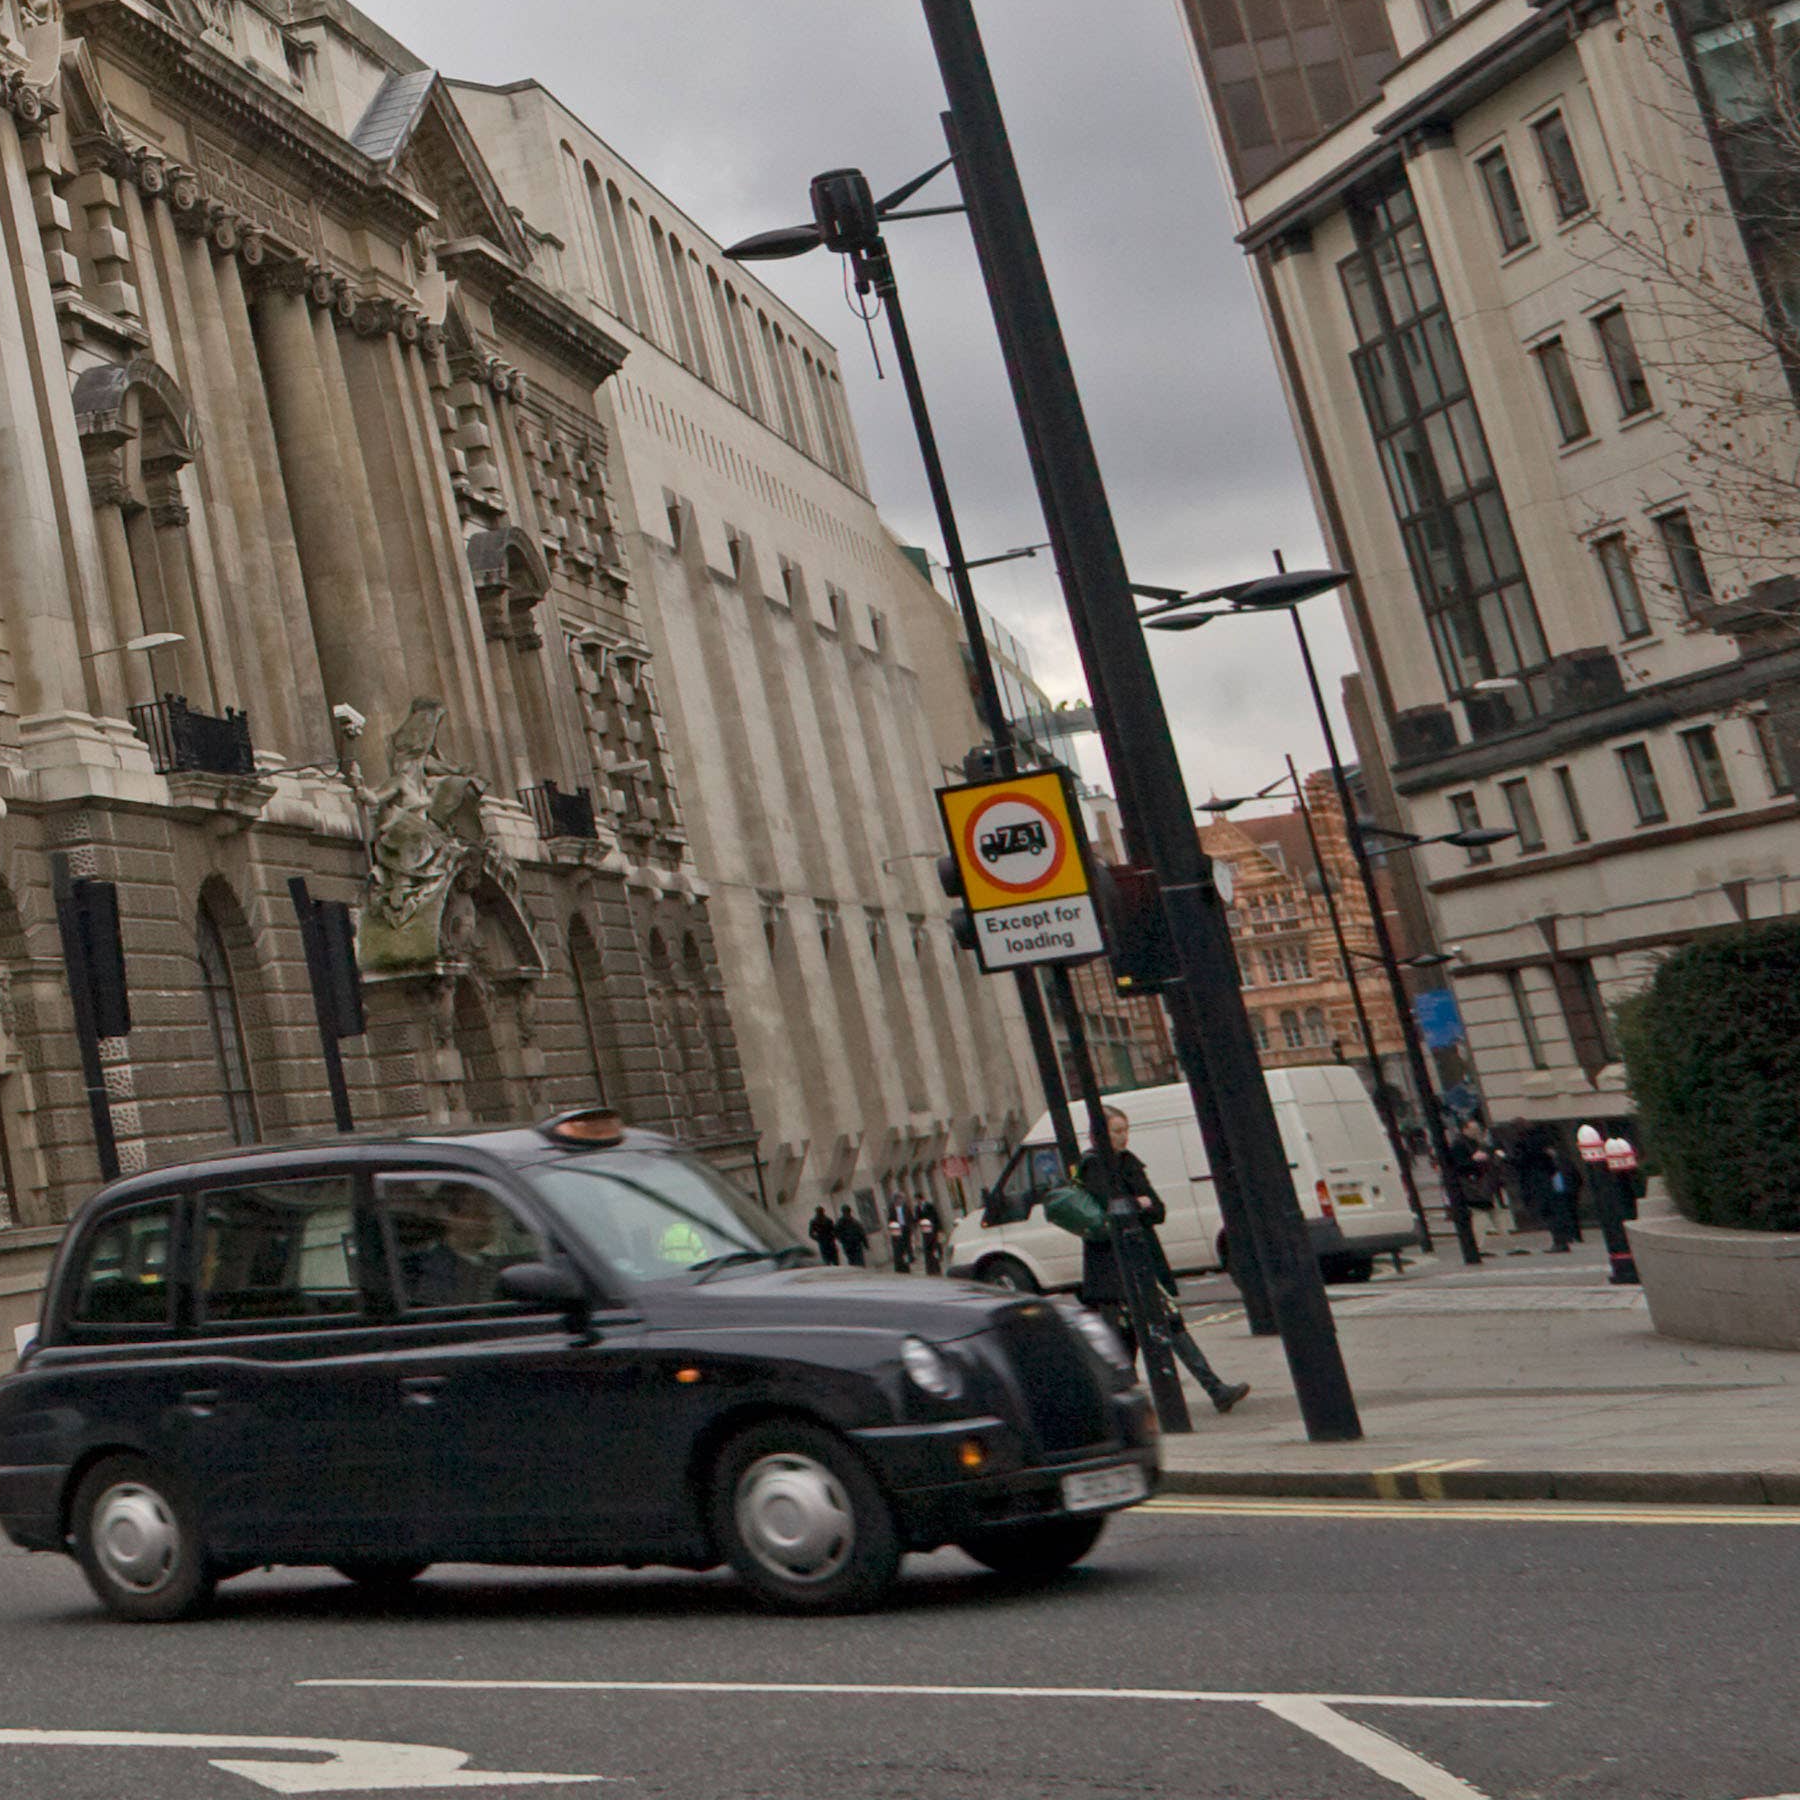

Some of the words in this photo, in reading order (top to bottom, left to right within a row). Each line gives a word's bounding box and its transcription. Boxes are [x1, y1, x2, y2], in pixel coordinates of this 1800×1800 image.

[984, 910, 1050, 934] Except
[1054, 905, 1082, 922] for
[1004, 931, 1076, 953] loading
